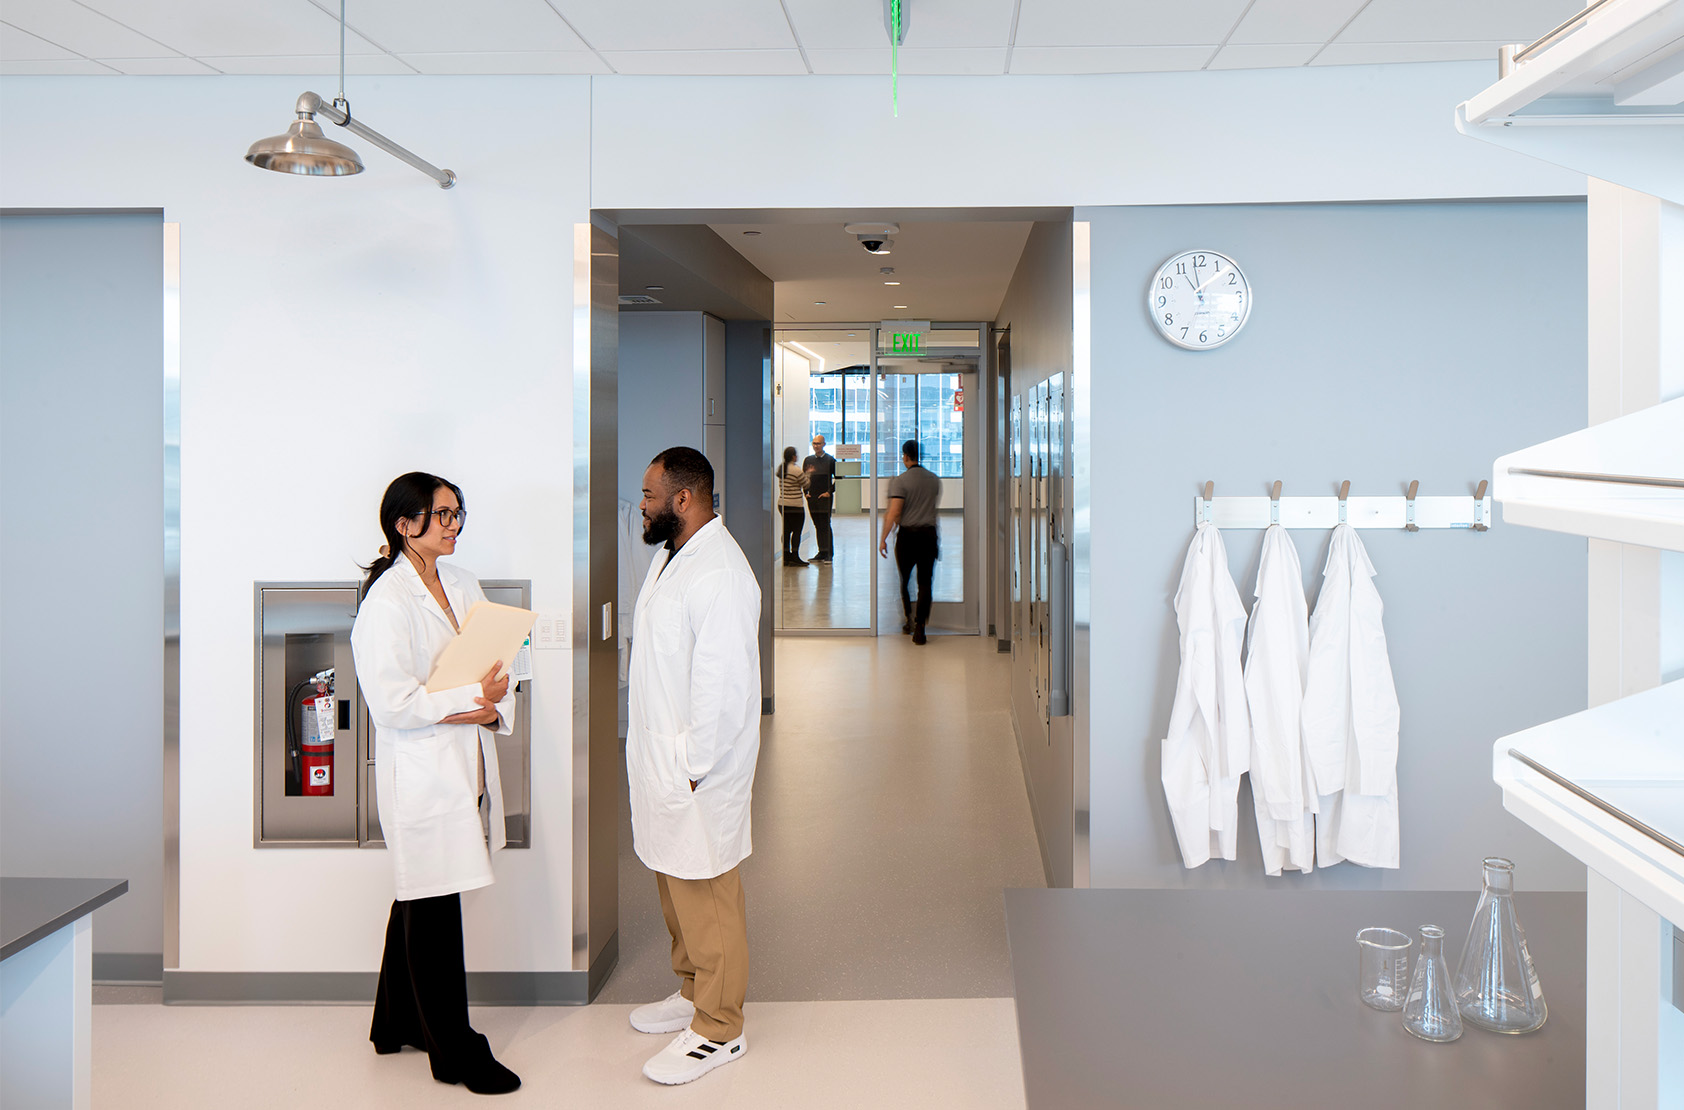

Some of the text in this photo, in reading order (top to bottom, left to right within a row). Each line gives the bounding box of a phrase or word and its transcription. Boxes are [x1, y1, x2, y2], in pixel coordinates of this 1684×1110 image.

[1192, 255, 1206, 267] 12
[1214, 260, 1220, 272] 1
[1176, 262, 1186, 274] 11
[1160, 277, 1173, 289] 10
[1228, 273, 1237, 285] 2
[1158, 296, 1166, 308] 9
[1164, 313, 1173, 325] 8
[1230, 312, 1239, 321] 4
[1180, 327, 1189, 339] 7
[1199, 330, 1207, 342] 6
[1217, 325, 1225, 337] 5
[893, 333, 921, 353] EXIT
